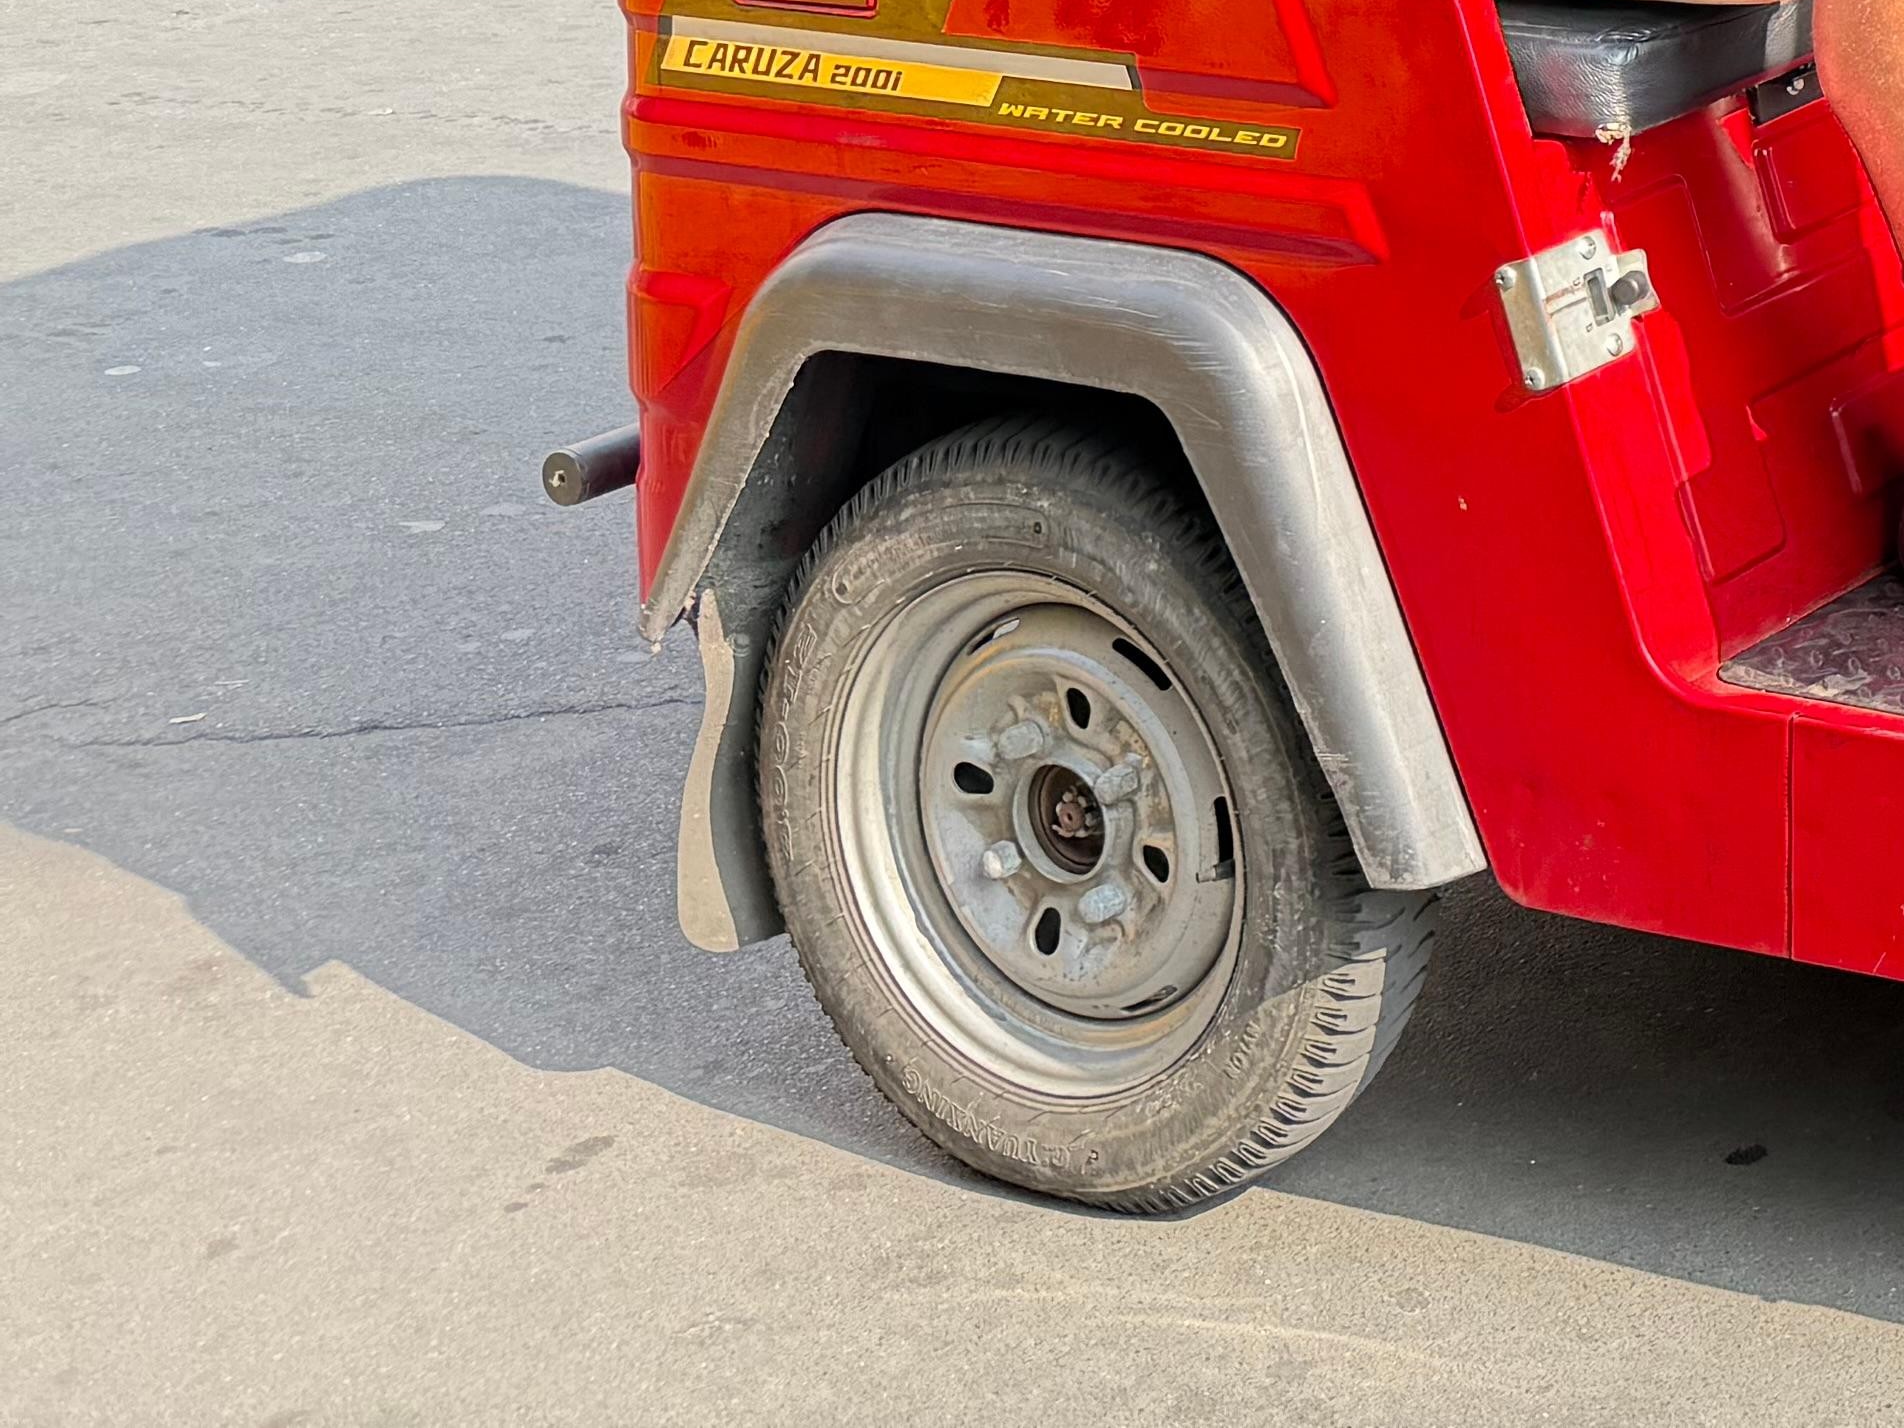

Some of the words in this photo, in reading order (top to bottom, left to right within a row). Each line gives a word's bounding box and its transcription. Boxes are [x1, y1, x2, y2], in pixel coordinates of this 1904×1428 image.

[683, 39, 822, 83] CARUZA
[998, 102, 1124, 129] WATER
[1134, 118, 1288, 148] COOLED
